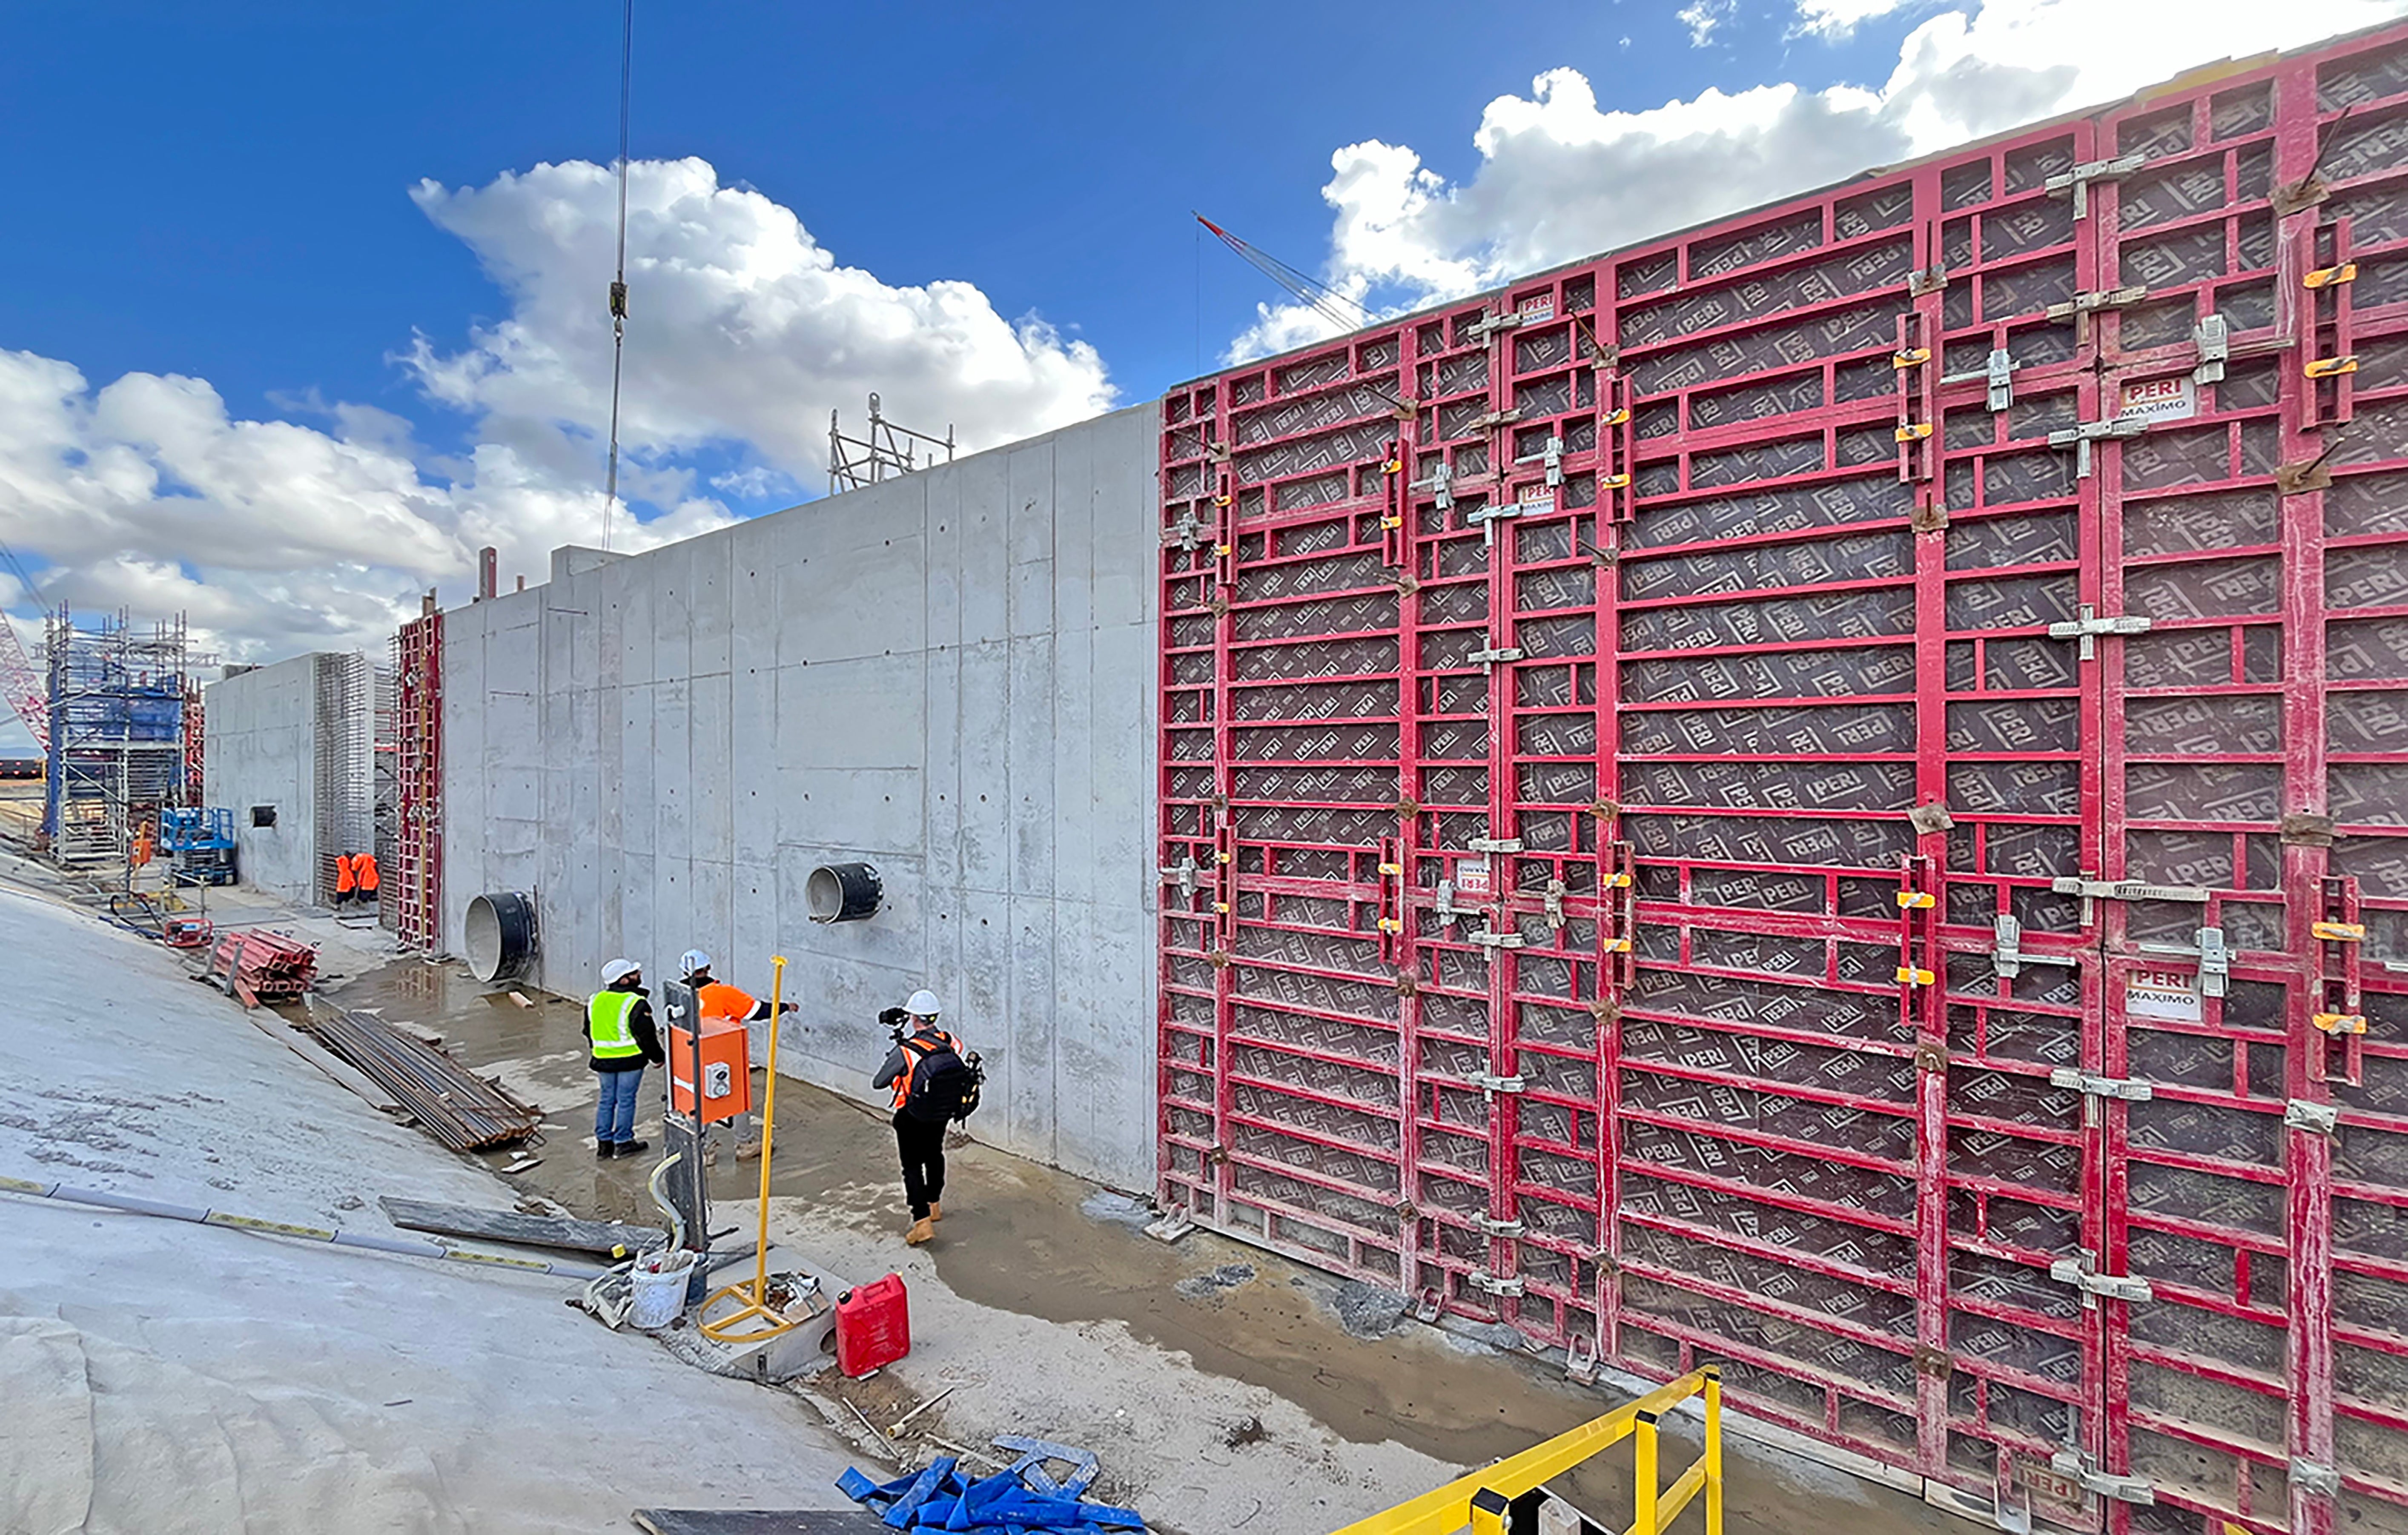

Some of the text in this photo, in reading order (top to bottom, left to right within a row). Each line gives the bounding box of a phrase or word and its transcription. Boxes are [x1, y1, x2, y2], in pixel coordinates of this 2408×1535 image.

[1838, 212, 1870, 235] PER
[1852, 248, 1899, 280] PERI
[1525, 295, 1553, 311] PERI
[1683, 301, 1723, 331] PERI
[1789, 331, 1815, 362] PER
[2129, 381, 2182, 400] PERI
[1318, 405, 1343, 426] PERI
[2121, 401, 2186, 418] MAXIMO
[1823, 488, 1858, 520] PERI
[1652, 515, 1694, 542] PERI
[1720, 519, 1757, 539] PER
[1633, 564, 1671, 587] PERI
[1786, 547, 1822, 581] PERI
[2140, 586, 2180, 620] ERI
[1732, 607, 1763, 643] PERI
[1773, 605, 1808, 640] PERI
[1838, 617, 1868, 637] ERI
[1982, 605, 2037, 629] PERI
[1673, 628, 1718, 649] PERI
[2176, 629, 2231, 661] PER
[2010, 645, 2054, 684] PERI
[1697, 661, 1729, 694] PERI
[1685, 713, 1716, 747] PERI
[1838, 719, 1887, 745] PERI
[1993, 709, 2037, 744] PERI
[2140, 705, 2204, 736] PERI
[1532, 733, 1556, 755] ERI
[1570, 730, 1594, 747] ERI
[1633, 733, 1670, 753] PERI
[1787, 730, 1816, 753] ERI
[1551, 768, 1587, 790] PERI
[1653, 768, 1683, 799] PERI
[1814, 771, 1860, 795] PERI
[1949, 771, 1991, 807] PERI
[1533, 824, 1565, 843] PERI
[1642, 819, 1670, 850] PERI
[1786, 832, 1834, 856] PERI
[1697, 838, 1724, 860] ERI
[2177, 855, 2231, 882] PER
[1722, 877, 1757, 899] PER
[1763, 878, 1809, 901] PERI
[1763, 951, 1795, 971] PERI
[1642, 972, 1681, 991] PERI
[2044, 980, 2080, 1002] PER
[2138, 971, 2187, 988] PERI
[2128, 991, 2195, 1005] MAXIMO
[1762, 1000, 1795, 1022] PERI
[1826, 1004, 1861, 1028] PERI
[1686, 1047, 1727, 1067] PERI
[1763, 1042, 1795, 1064] PERI
[1826, 1056, 1860, 1079] PERI
[1966, 1077, 2006, 1101] PERI
[1643, 1143, 1681, 1160] PERI
[1695, 1134, 1726, 1167] PERI
[1825, 1292, 1860, 1313] PERI
[1970, 1330, 2004, 1352] PERI
[2020, 1470, 2067, 1496] PERI
